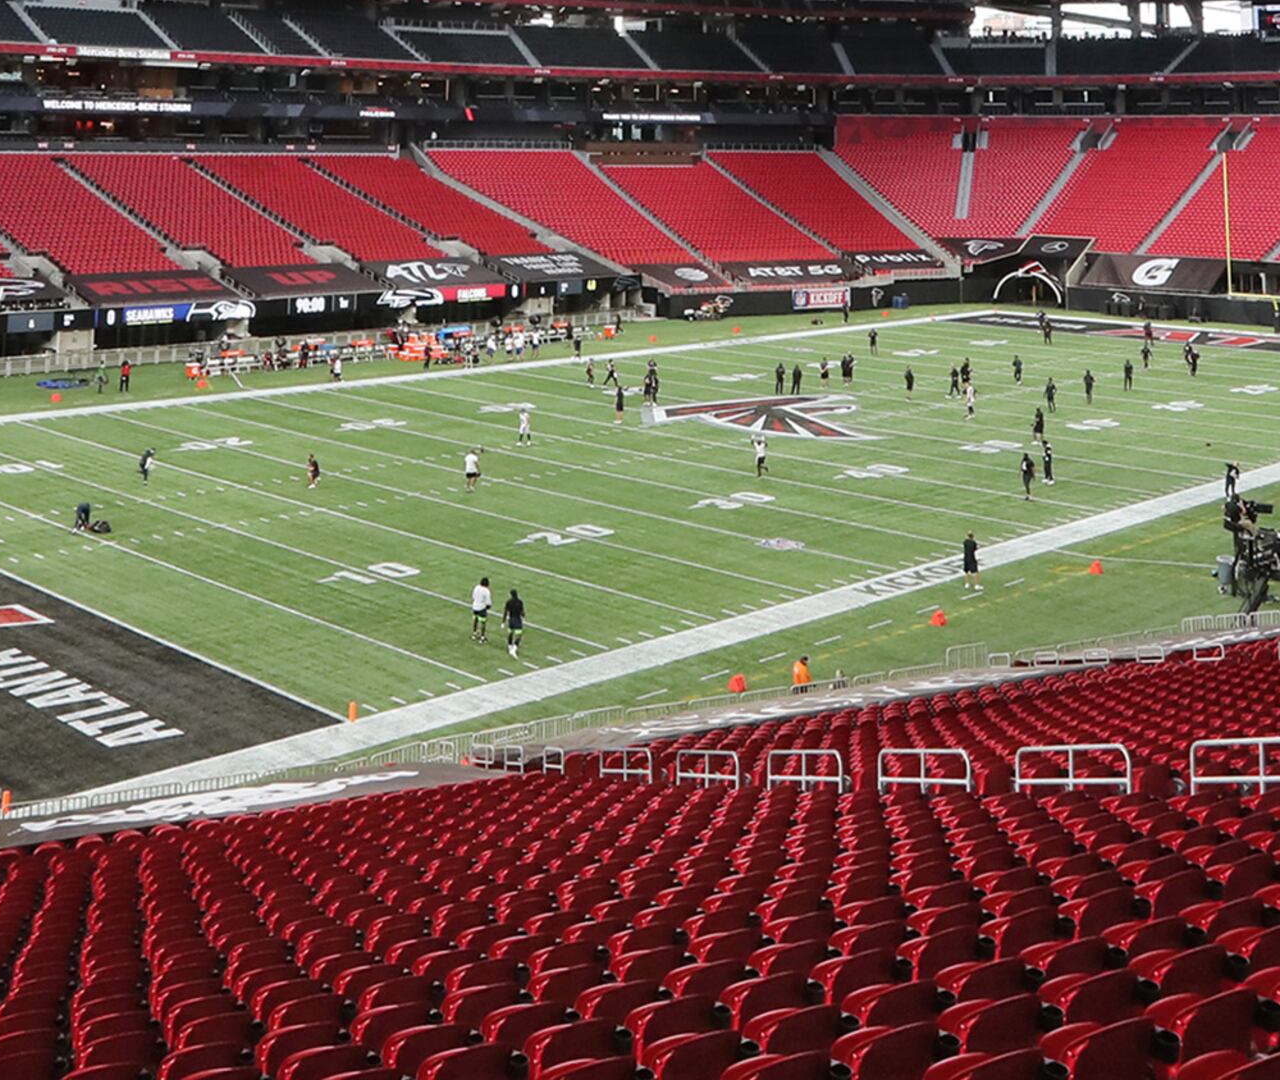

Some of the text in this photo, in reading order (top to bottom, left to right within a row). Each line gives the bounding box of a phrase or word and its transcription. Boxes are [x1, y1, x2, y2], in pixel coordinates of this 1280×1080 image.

[42, 100, 82, 109] WELCOME
[84, 100, 94, 109] TO
[855, 253, 931, 264] Publix
[268, 270, 337, 285] UP
[386, 262, 447, 283] ATL
[748, 264, 843, 277] AT&T 5G
[1131, 258, 1181, 286] G
[86, 277, 223, 296] RISE
[810, 291, 844, 305] KICKOFF
[126, 307, 174, 322] SEAHAWKS
[515, 523, 615, 546] 20
[317, 561, 421, 586] 10
